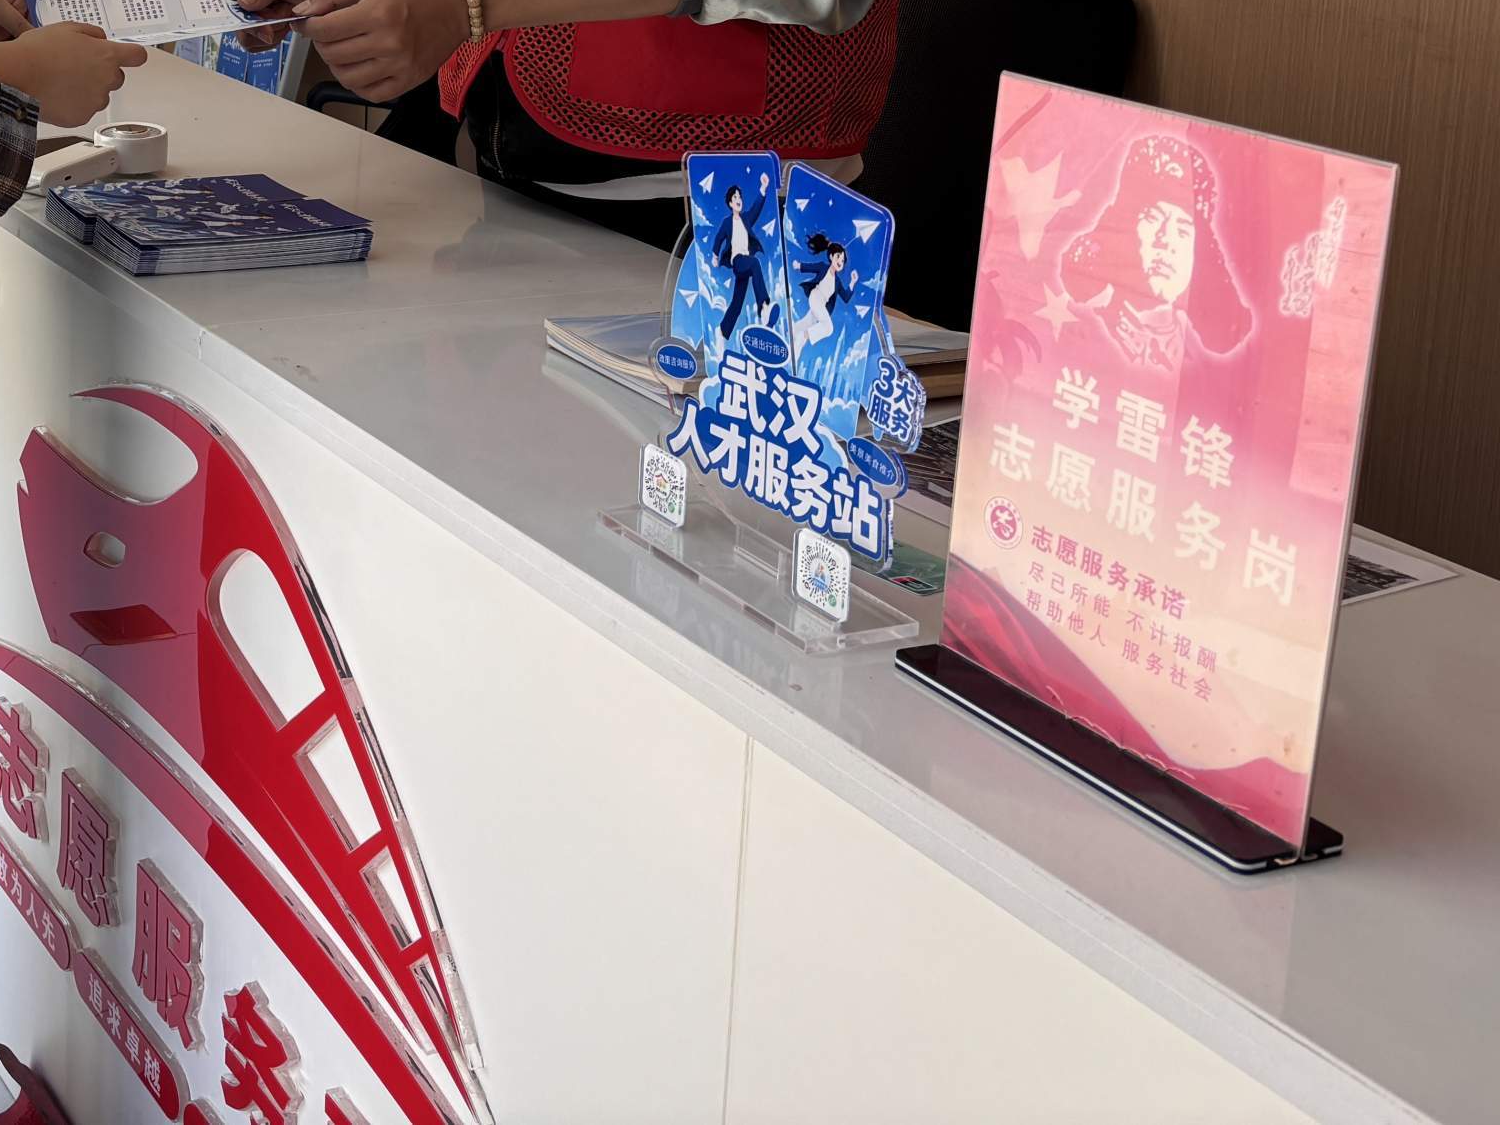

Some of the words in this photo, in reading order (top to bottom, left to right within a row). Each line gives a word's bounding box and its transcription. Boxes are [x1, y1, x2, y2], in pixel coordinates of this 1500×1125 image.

[743, 334, 789, 358] 交通出行指引
[874, 360, 917, 413] 3大
[719, 354, 821, 452] 武汉
[869, 394, 911, 441] 服务
[1052, 365, 1235, 491] 学雷锋
[668, 413, 881, 556] 人才服务站
[989, 421, 1299, 608] 志愿服务岗
[1028, 561, 1111, 618] 尽己所能
[1125, 610, 1217, 673] 不计报酬
[1031, 525, 1187, 620] 志愿服务承诺
[1026, 589, 1106, 647] 帮助他人
[1121, 638, 1214, 702] 服务社会
[87, 973, 162, 1099] 追求卓越
